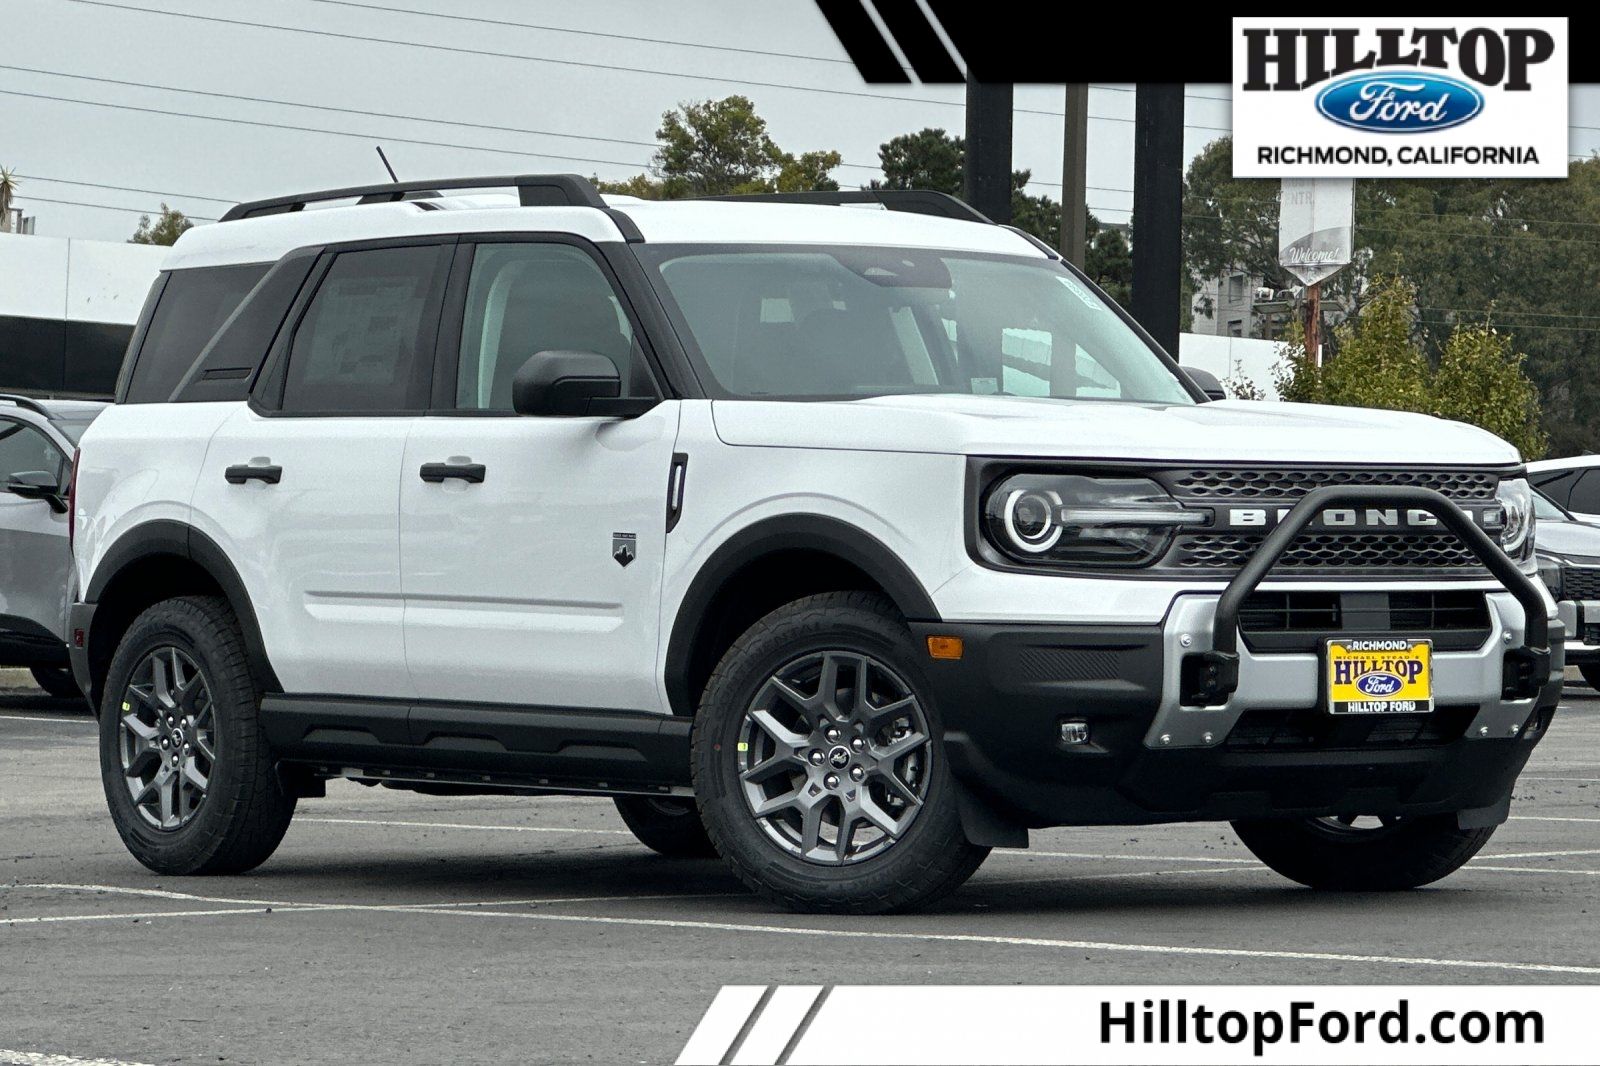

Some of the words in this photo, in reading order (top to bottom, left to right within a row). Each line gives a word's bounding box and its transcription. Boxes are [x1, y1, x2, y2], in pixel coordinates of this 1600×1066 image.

[1289, 247, 1340, 263] Welcome!
[1229, 508, 1475, 526] BONC
[1352, 641, 1407, 650] RICHMOND
[1334, 660, 1423, 685] HILLTOP
[1365, 676, 1395, 693] Ford
[1347, 702, 1388, 712] HILLTOP
[1389, 701, 1416, 712] FORD
